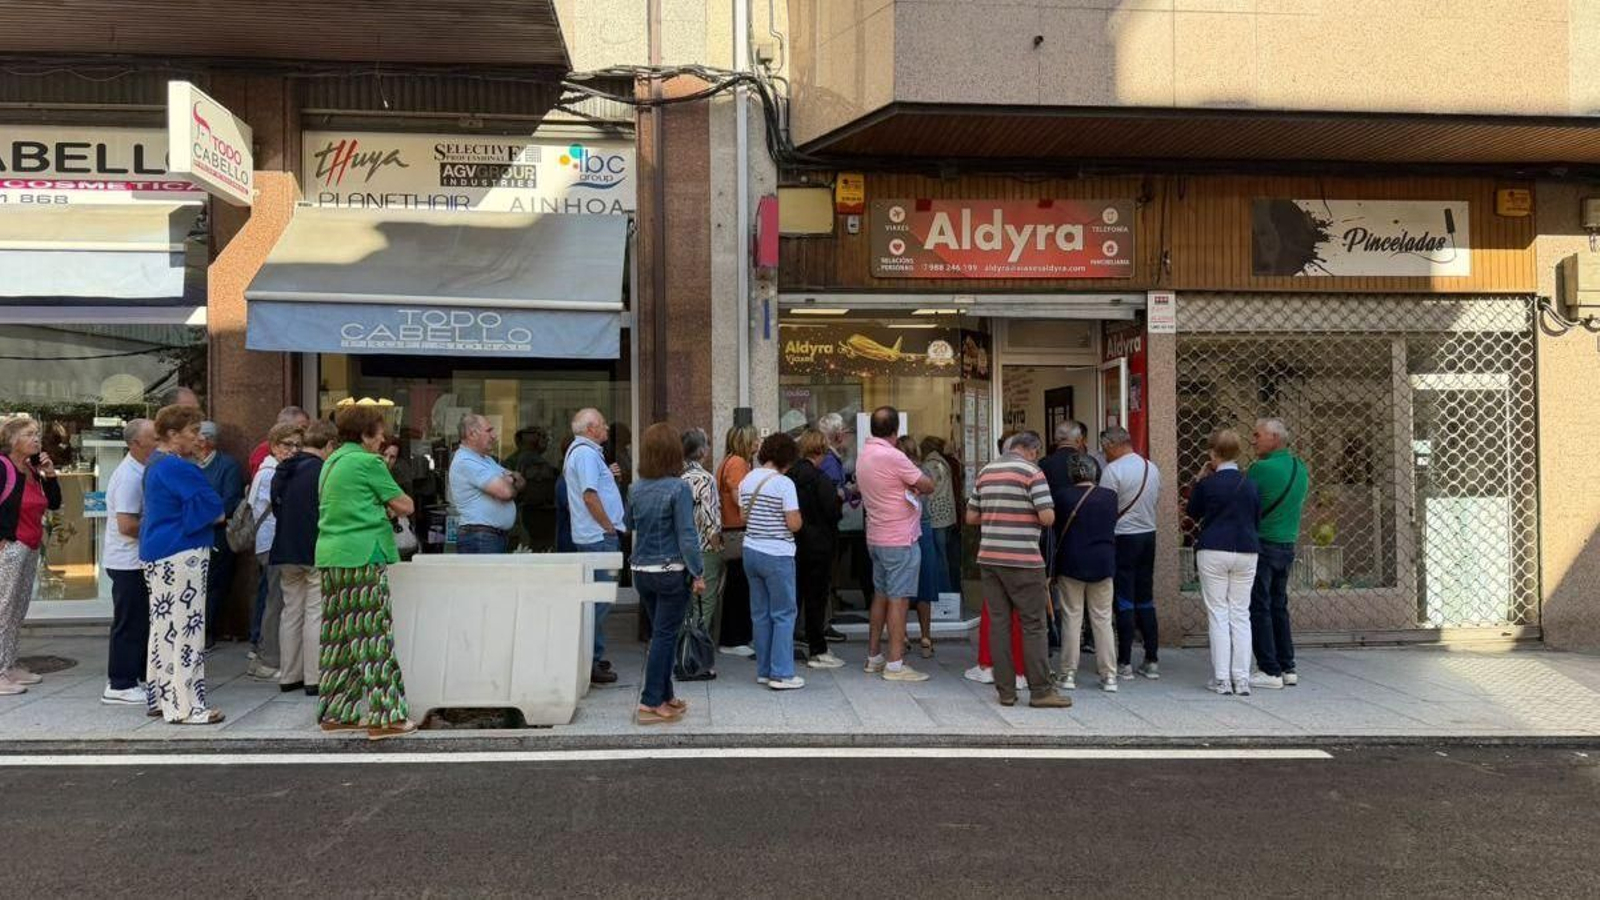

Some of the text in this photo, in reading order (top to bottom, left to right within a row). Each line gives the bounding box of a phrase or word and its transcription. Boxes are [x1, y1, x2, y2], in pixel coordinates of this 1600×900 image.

[0, 141, 170, 174] BELL
[212, 135, 242, 166] TODO
[434, 143, 522, 162] SELECTIVE
[193, 142, 249, 186] CABELLO
[443, 179, 534, 188] INDUSTRIES
[580, 173, 614, 182] group
[20, 194, 69, 204] 868
[510, 196, 626, 214] AINHOA
[923, 208, 1084, 263] Aldyra
[1341, 227, 1447, 253] Pinceladas
[398, 310, 502, 328] TODO
[341, 323, 532, 344] CABELLO
[785, 340, 834, 357] Aldyra
[1106, 332, 1142, 359] Aldyra
